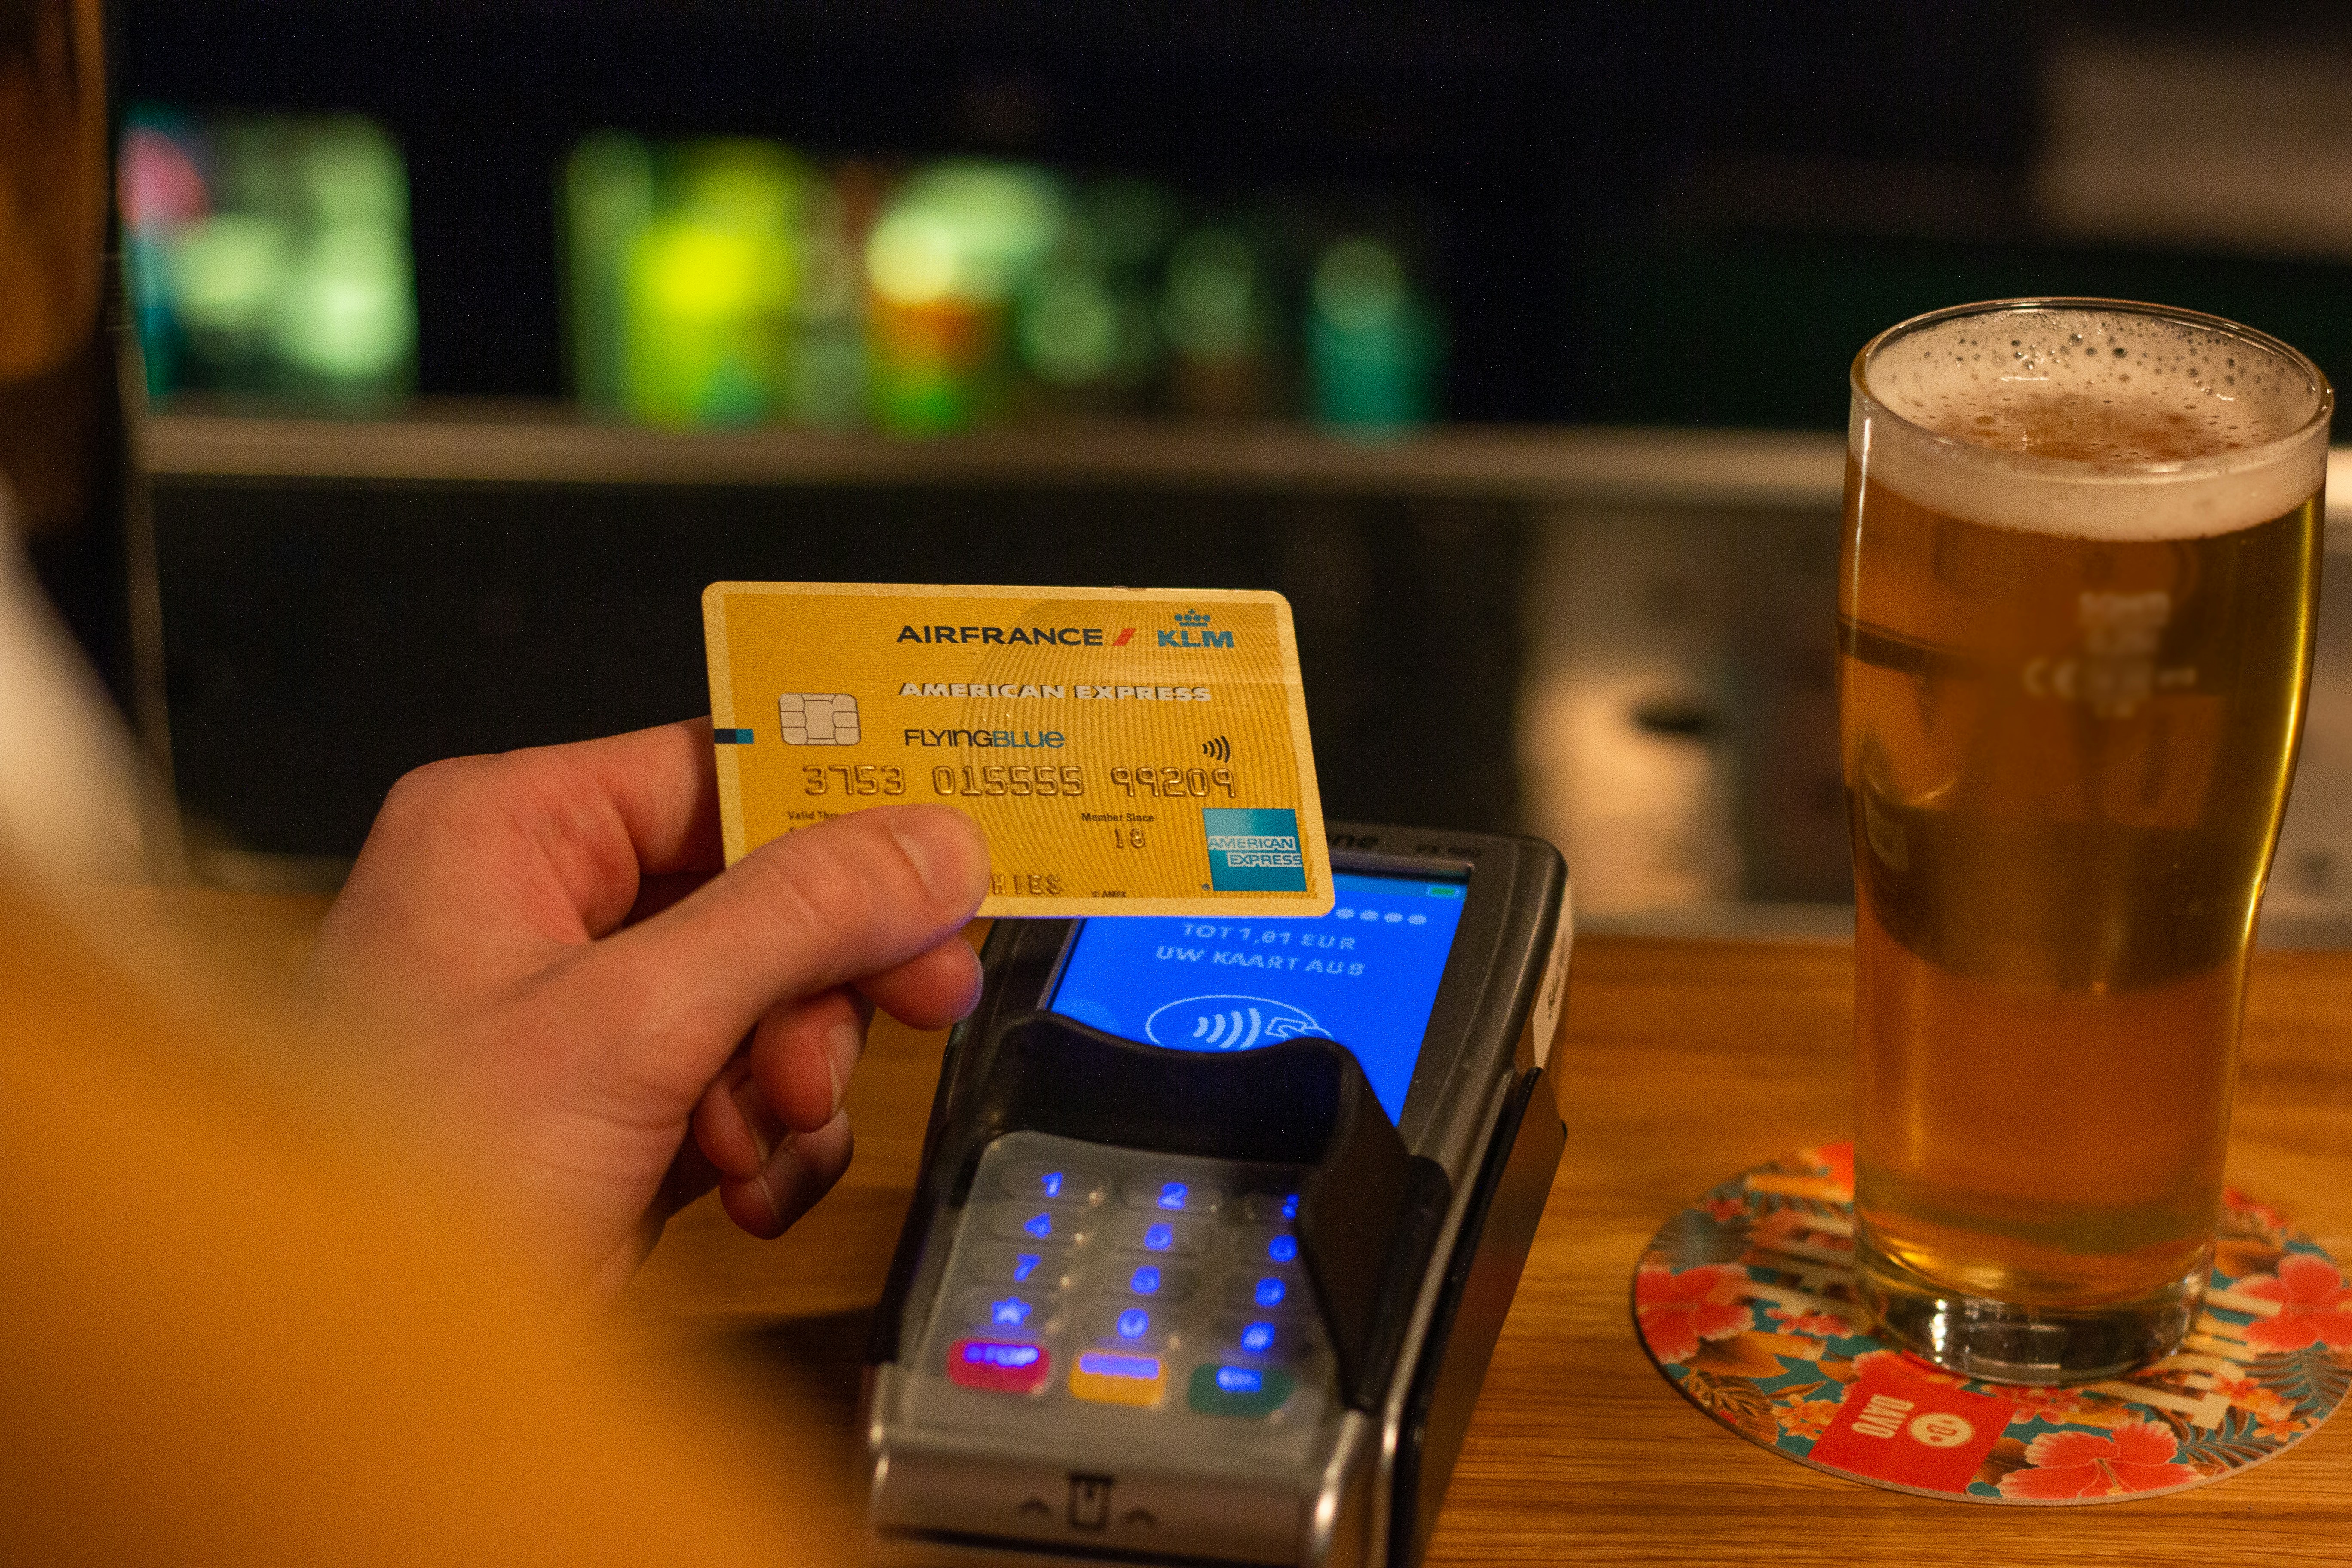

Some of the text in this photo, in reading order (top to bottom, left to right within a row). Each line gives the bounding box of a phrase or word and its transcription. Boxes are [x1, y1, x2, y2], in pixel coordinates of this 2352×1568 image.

[897, 625, 1103, 646] AIRFRANCE
[1157, 630, 1234, 648] KLM
[900, 683, 1212, 702] AMERICAN EXPRESS
[802, 764, 1236, 798] 3753 015555 99209
[788, 811, 814, 820] Valid
[1081, 813, 1154, 822] Member Since
[1114, 828, 1146, 849] 18
[1208, 836, 1294, 849] AMERICAN
[1228, 853, 1303, 866] EXPRESS
[991, 874, 1061, 895] HIES
[1183, 922, 1233, 940] TOT
[1301, 934, 1356, 950] EUR
[1156, 946, 1365, 976] UW KAART AUB
[1158, 1182, 1188, 1210] 2
